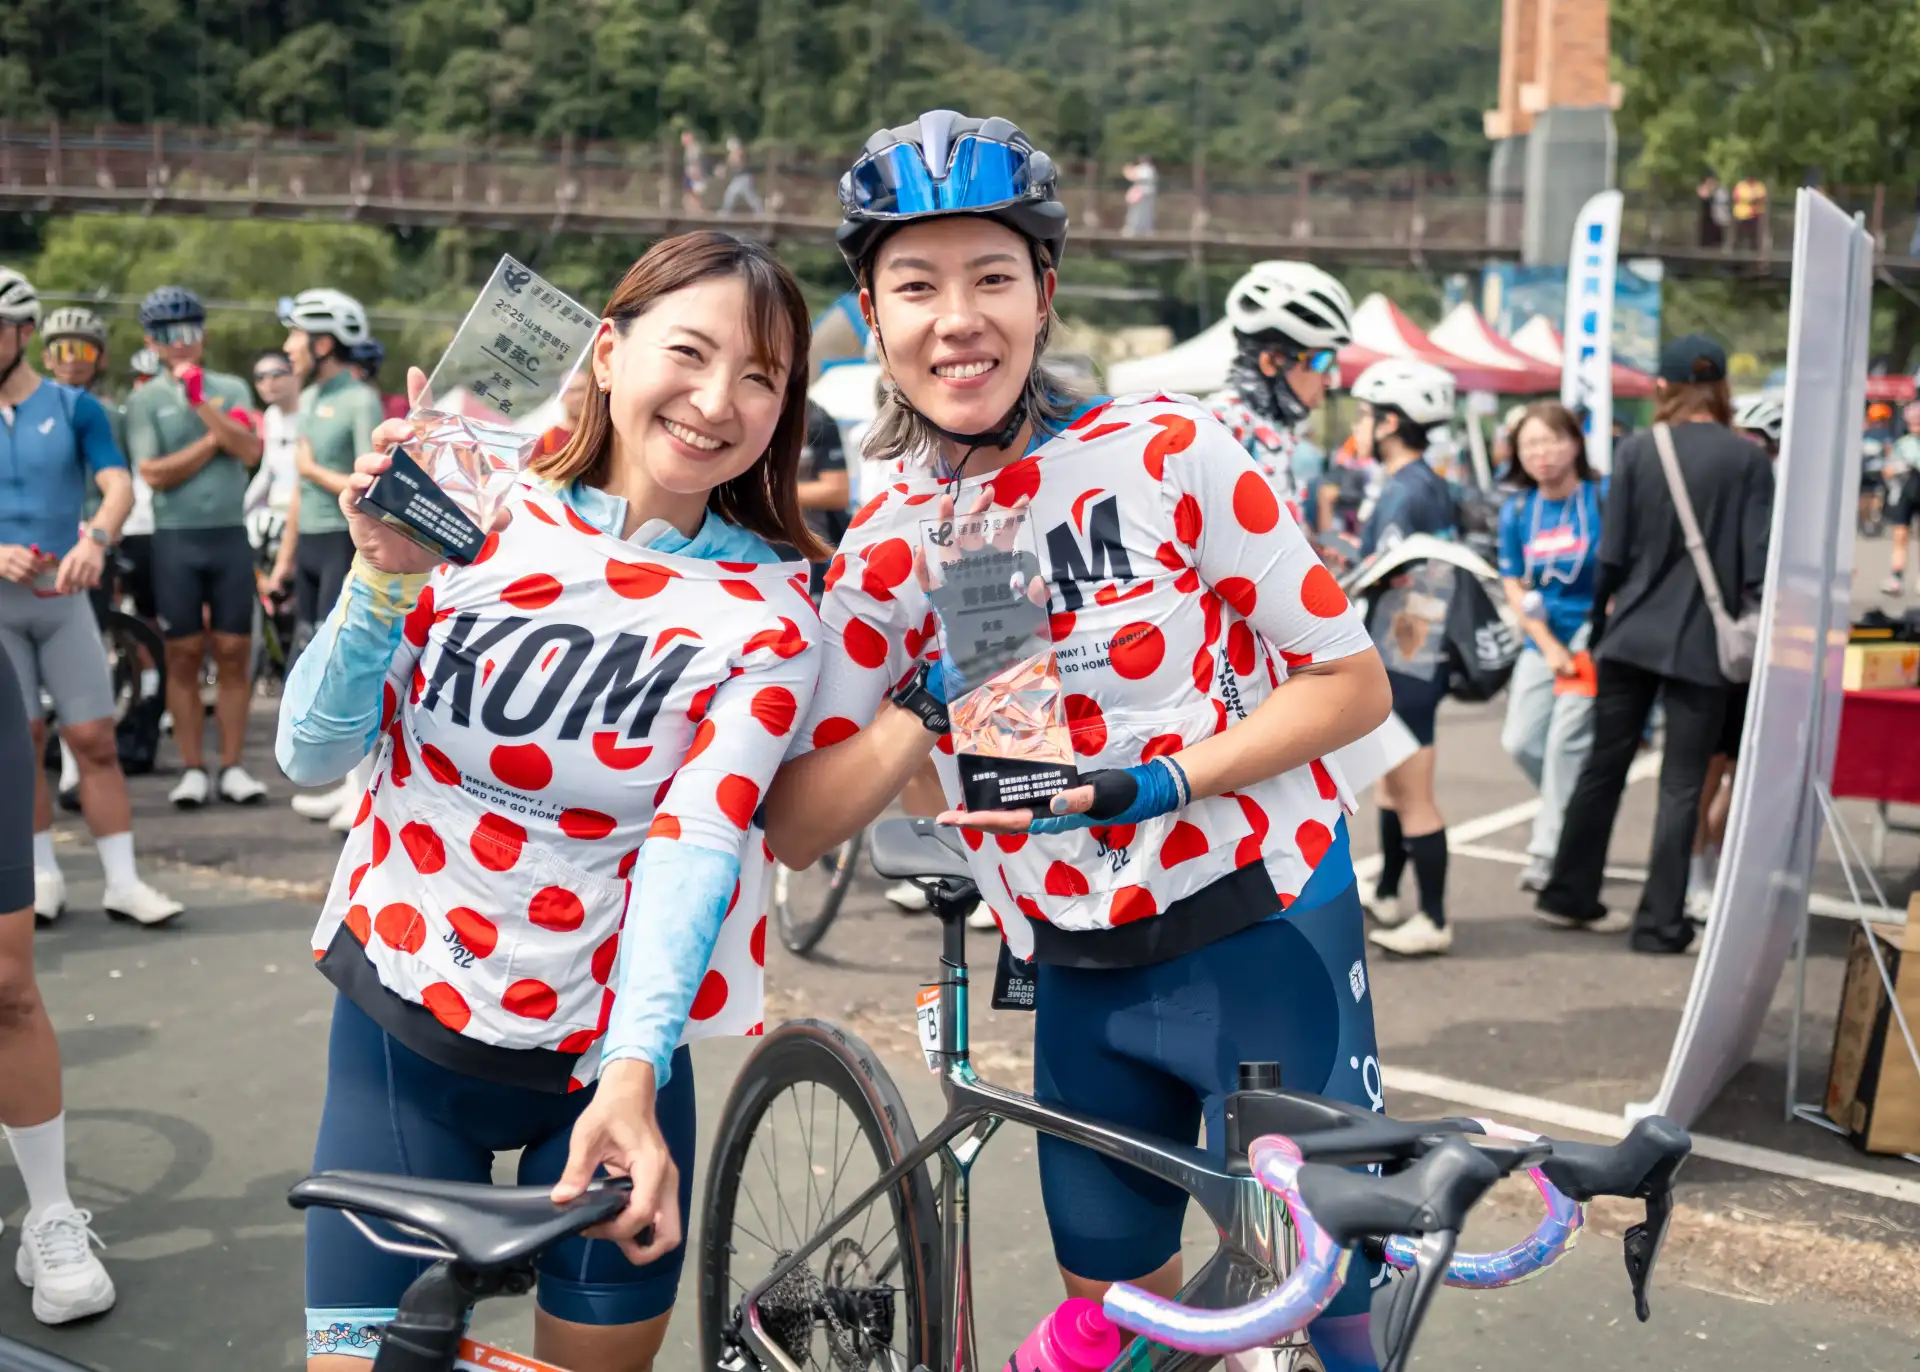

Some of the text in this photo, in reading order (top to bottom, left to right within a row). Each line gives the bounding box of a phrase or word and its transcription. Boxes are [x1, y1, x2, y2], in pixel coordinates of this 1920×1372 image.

[471, 380, 514, 414] 第一名
[1046, 495, 1137, 614] M
[1056, 648, 1078, 659] AWAY
[1065, 663, 1079, 673] GO
[1082, 657, 1112, 670] HOME
[423, 612, 705, 741] KOM
[1218, 674, 1234, 713] NAN
[490, 796, 507, 807] OR
[510, 803, 526, 813] GO
[529, 808, 561, 822] HOME
[1008, 984, 1035, 992] HARD
